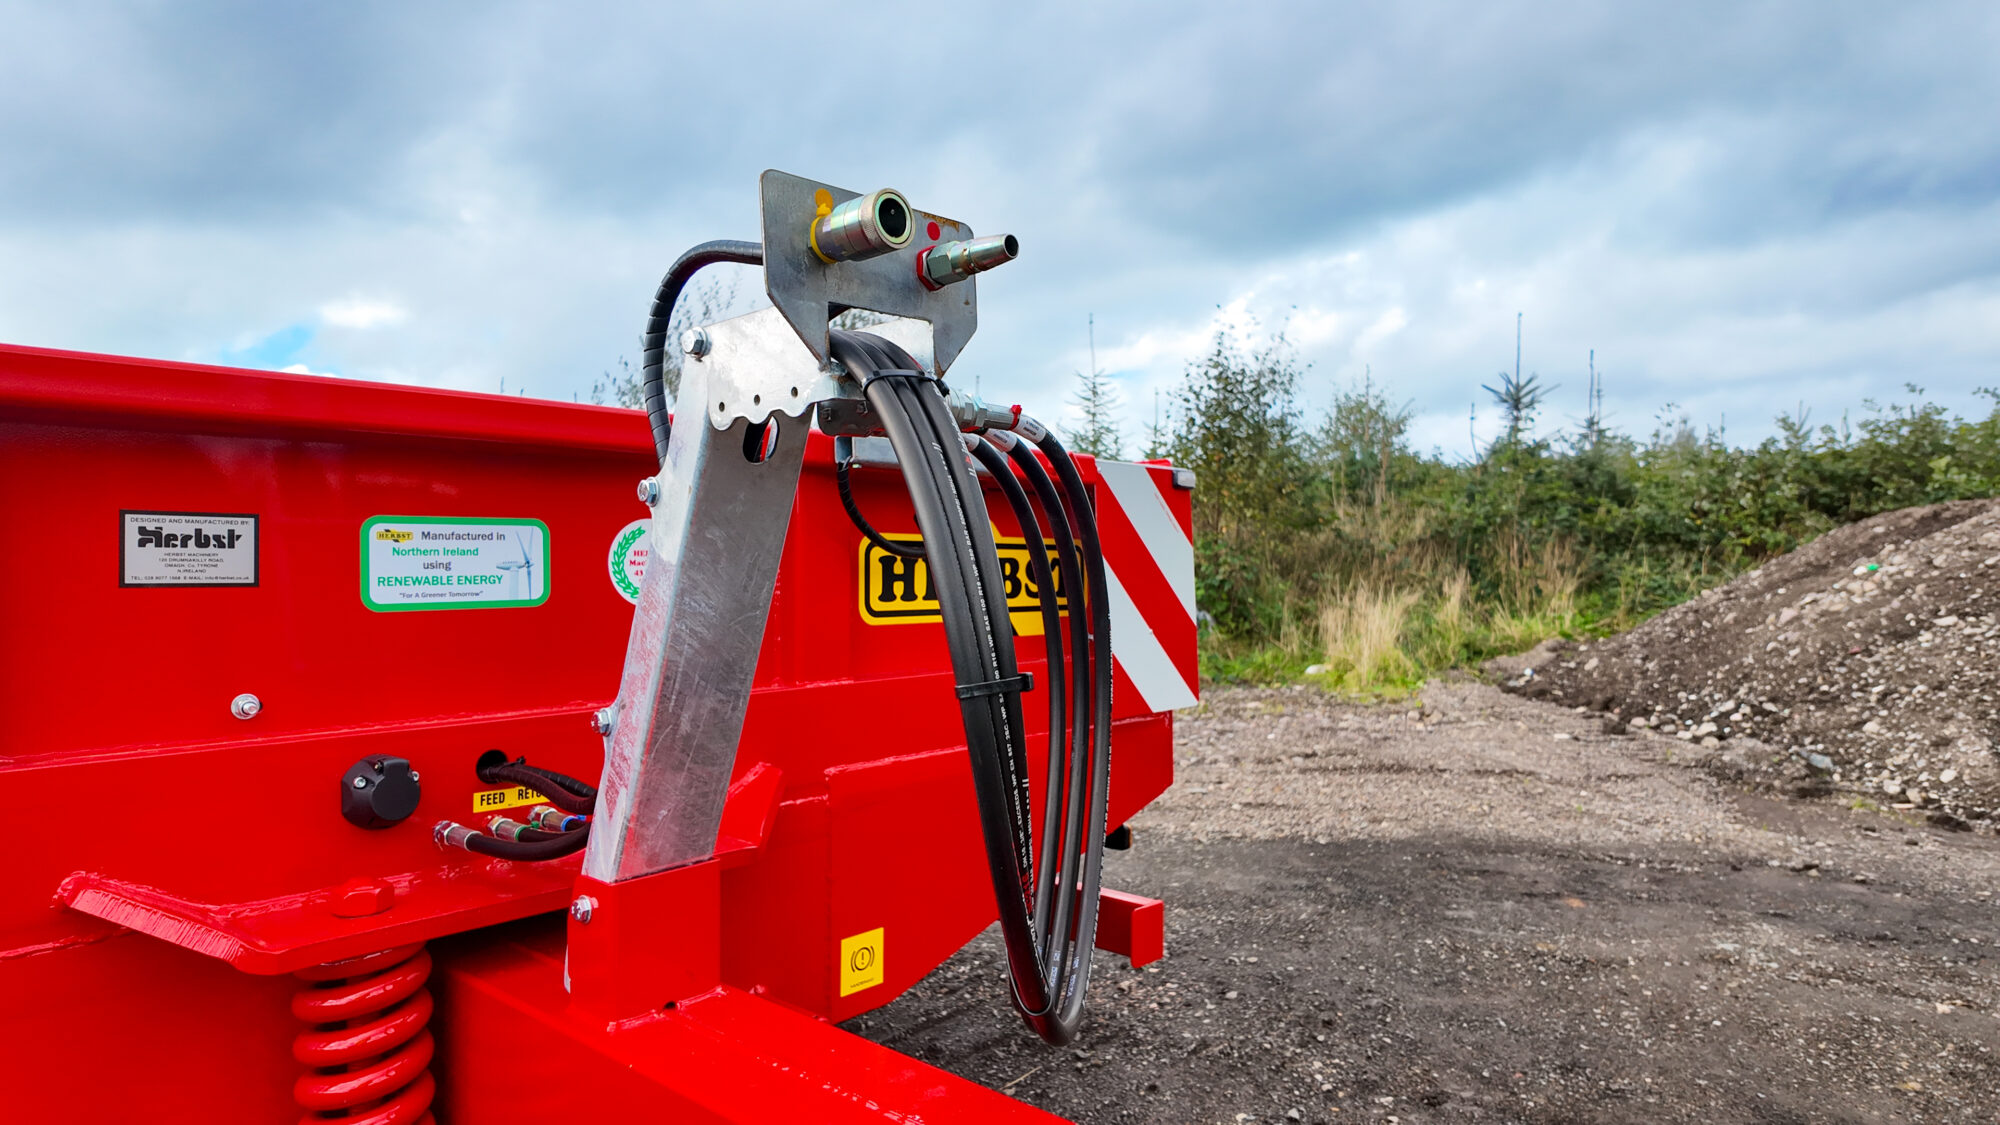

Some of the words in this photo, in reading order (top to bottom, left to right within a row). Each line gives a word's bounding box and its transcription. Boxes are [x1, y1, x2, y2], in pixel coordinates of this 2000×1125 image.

[184, 518, 239, 526] MANUFACTURED
[421, 531, 493, 541] Manufactured
[496, 532, 506, 541] in
[392, 546, 440, 557] Northern
[443, 546, 479, 556] Ireland
[423, 560, 452, 571] using
[377, 576, 453, 587] RENEWABLE
[457, 574, 504, 585] ENERGY
[982, 614, 991, 631] SAE
[986, 633, 994, 647] WP
[480, 792, 506, 806] FEED
